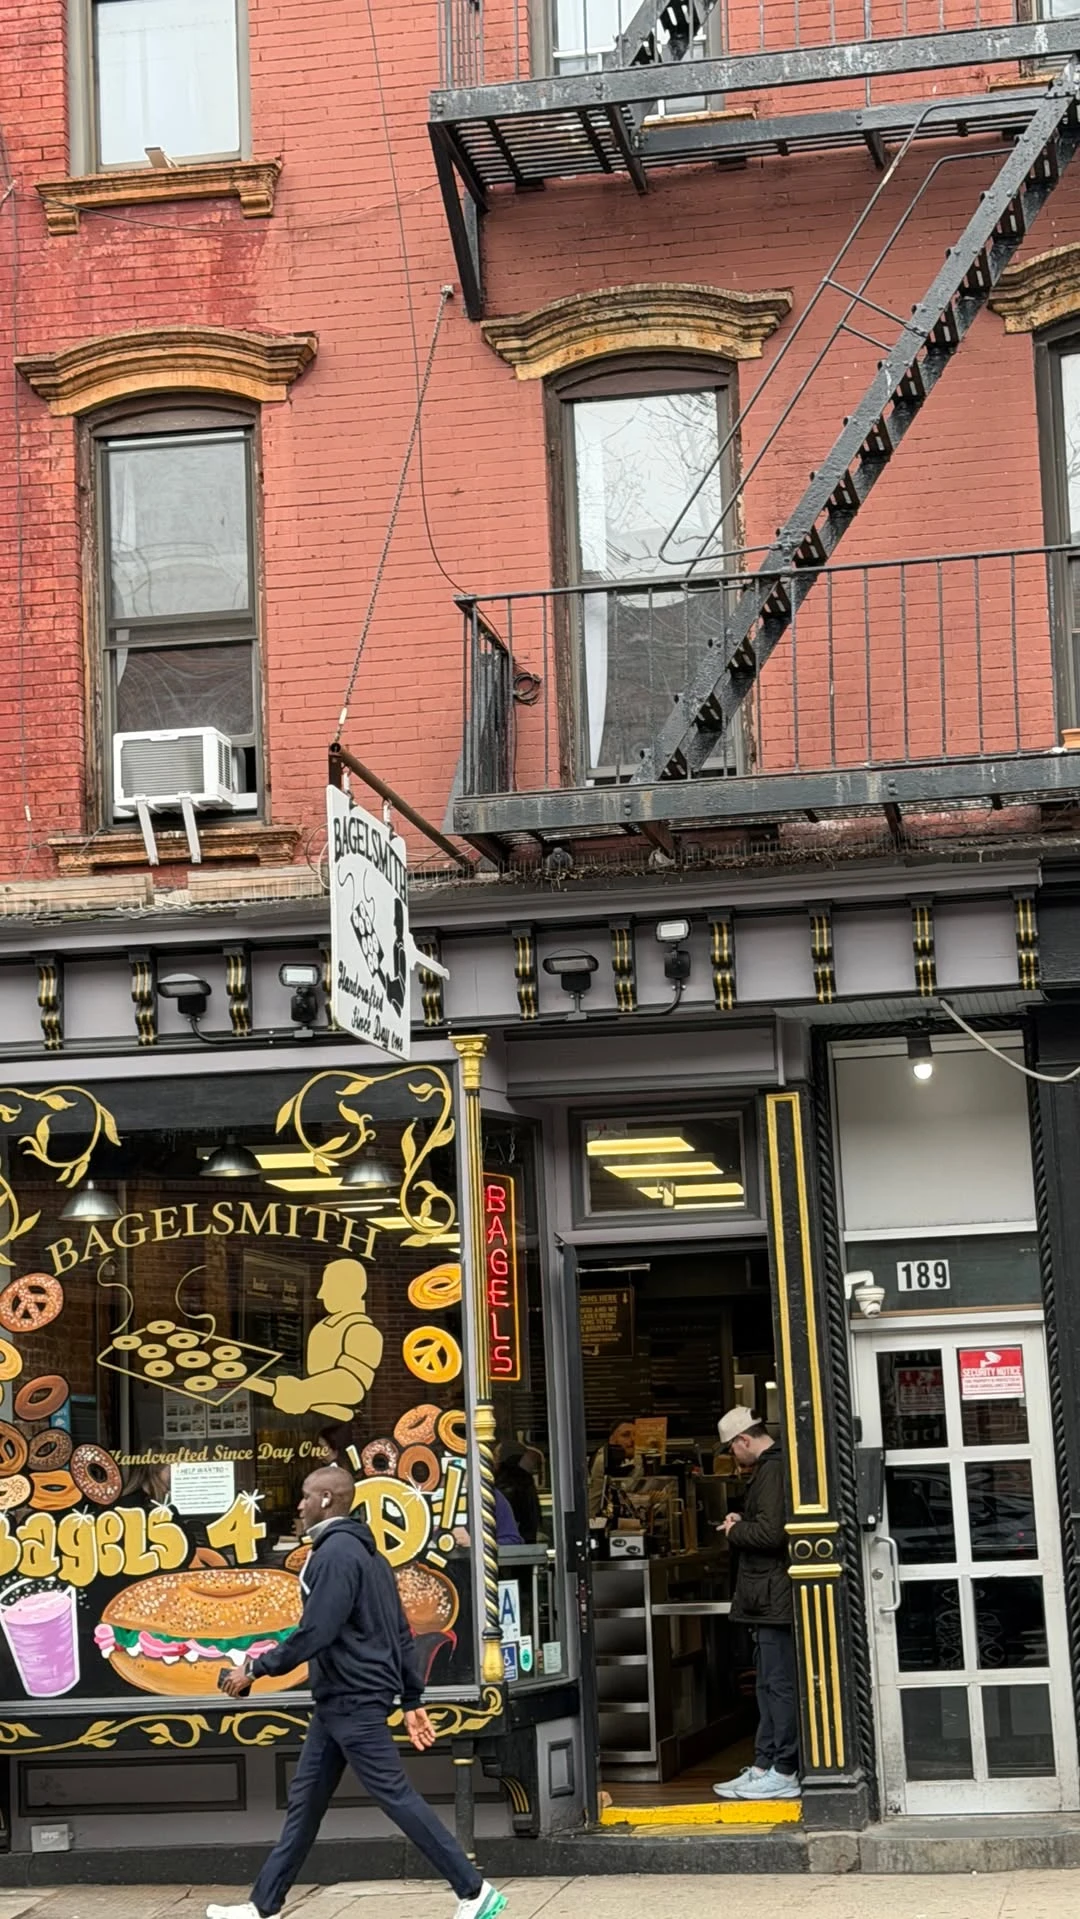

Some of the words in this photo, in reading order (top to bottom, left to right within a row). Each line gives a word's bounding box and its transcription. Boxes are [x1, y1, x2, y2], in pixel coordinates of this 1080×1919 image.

[334, 817, 408, 907] BAGELSMITH
[338, 960, 384, 1018] Handcrafted
[351, 1005, 371, 1034] Since
[373, 1014, 390, 1051] Day
[45, 1201, 382, 1277] BAGELSMITH
[486, 1184, 513, 1372] BAGELS
[901, 1261, 947, 1289] 189
[962, 1367, 996, 1377] SECURITY
[996, 1366, 1021, 1376] NOTICE
[180, 1467, 196, 1475] HELP
[212, 1444, 254, 1461] Since
[257, 1443, 295, 1464] Day
[299, 1440, 331, 1458] One
[206, 1493, 266, 1564] 4
[500, 1588, 516, 1625] A
